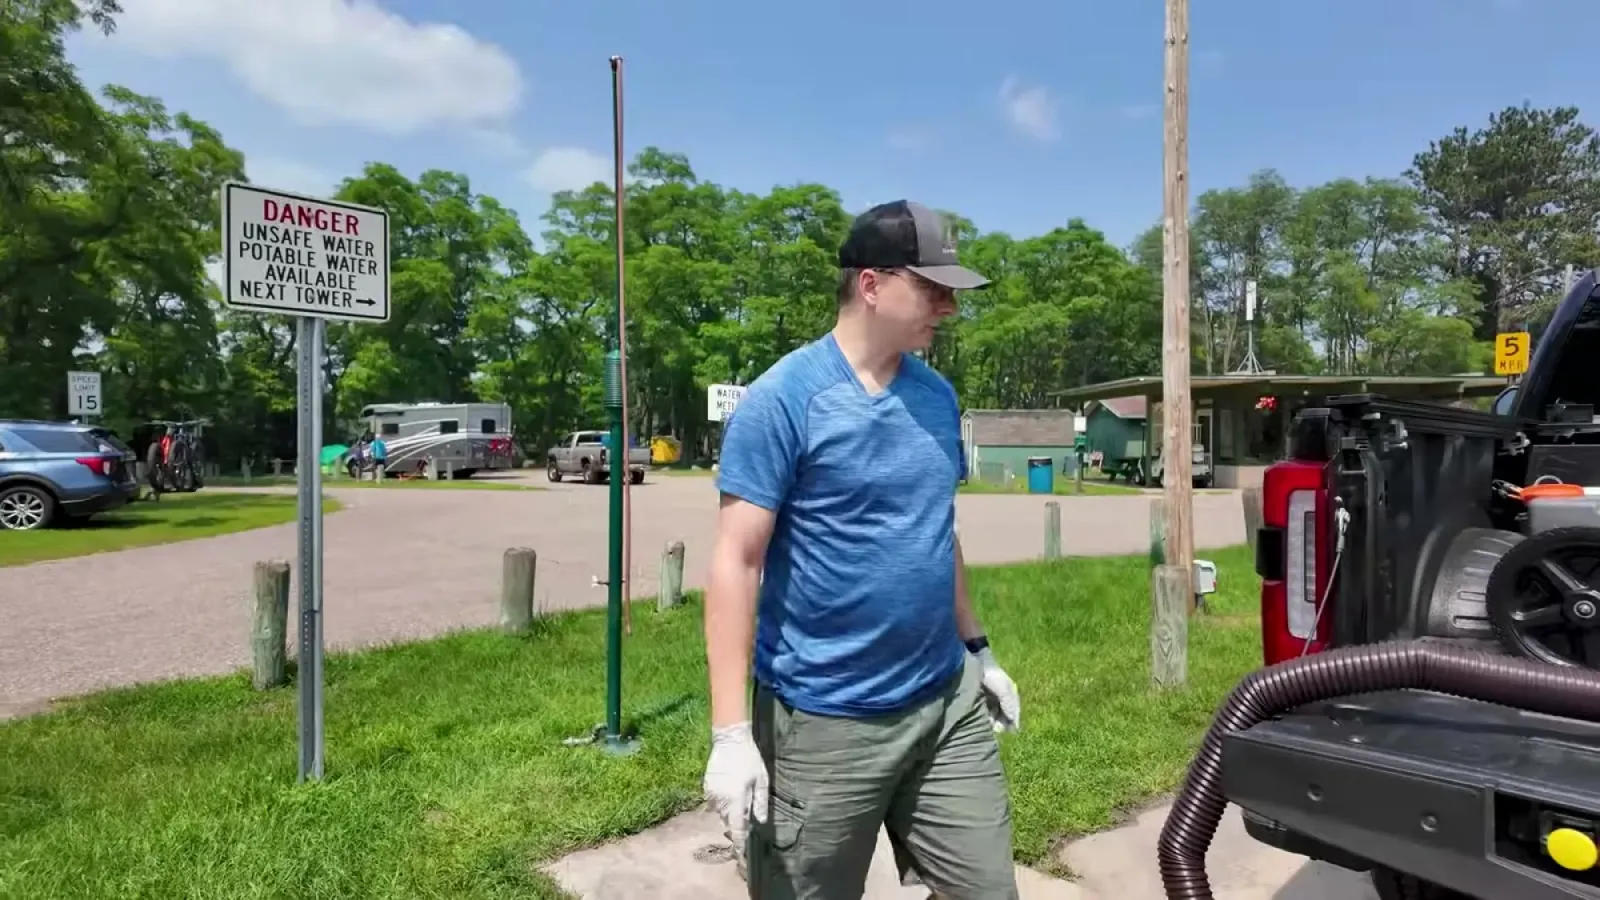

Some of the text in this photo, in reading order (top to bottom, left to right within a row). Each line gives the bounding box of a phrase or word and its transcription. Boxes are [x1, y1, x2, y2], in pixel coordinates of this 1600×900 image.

[263, 199, 359, 236] DANGER
[243, 222, 374, 257] UNSAFE WATER
[239, 241, 378, 276] POTABLE WATER
[265, 264, 357, 291] AVAILABLE
[240, 280, 352, 308] NEXT TOWER
[1504, 336, 1520, 357] 5
[78, 395, 98, 410] 15
[716, 388, 741, 400] WATER
